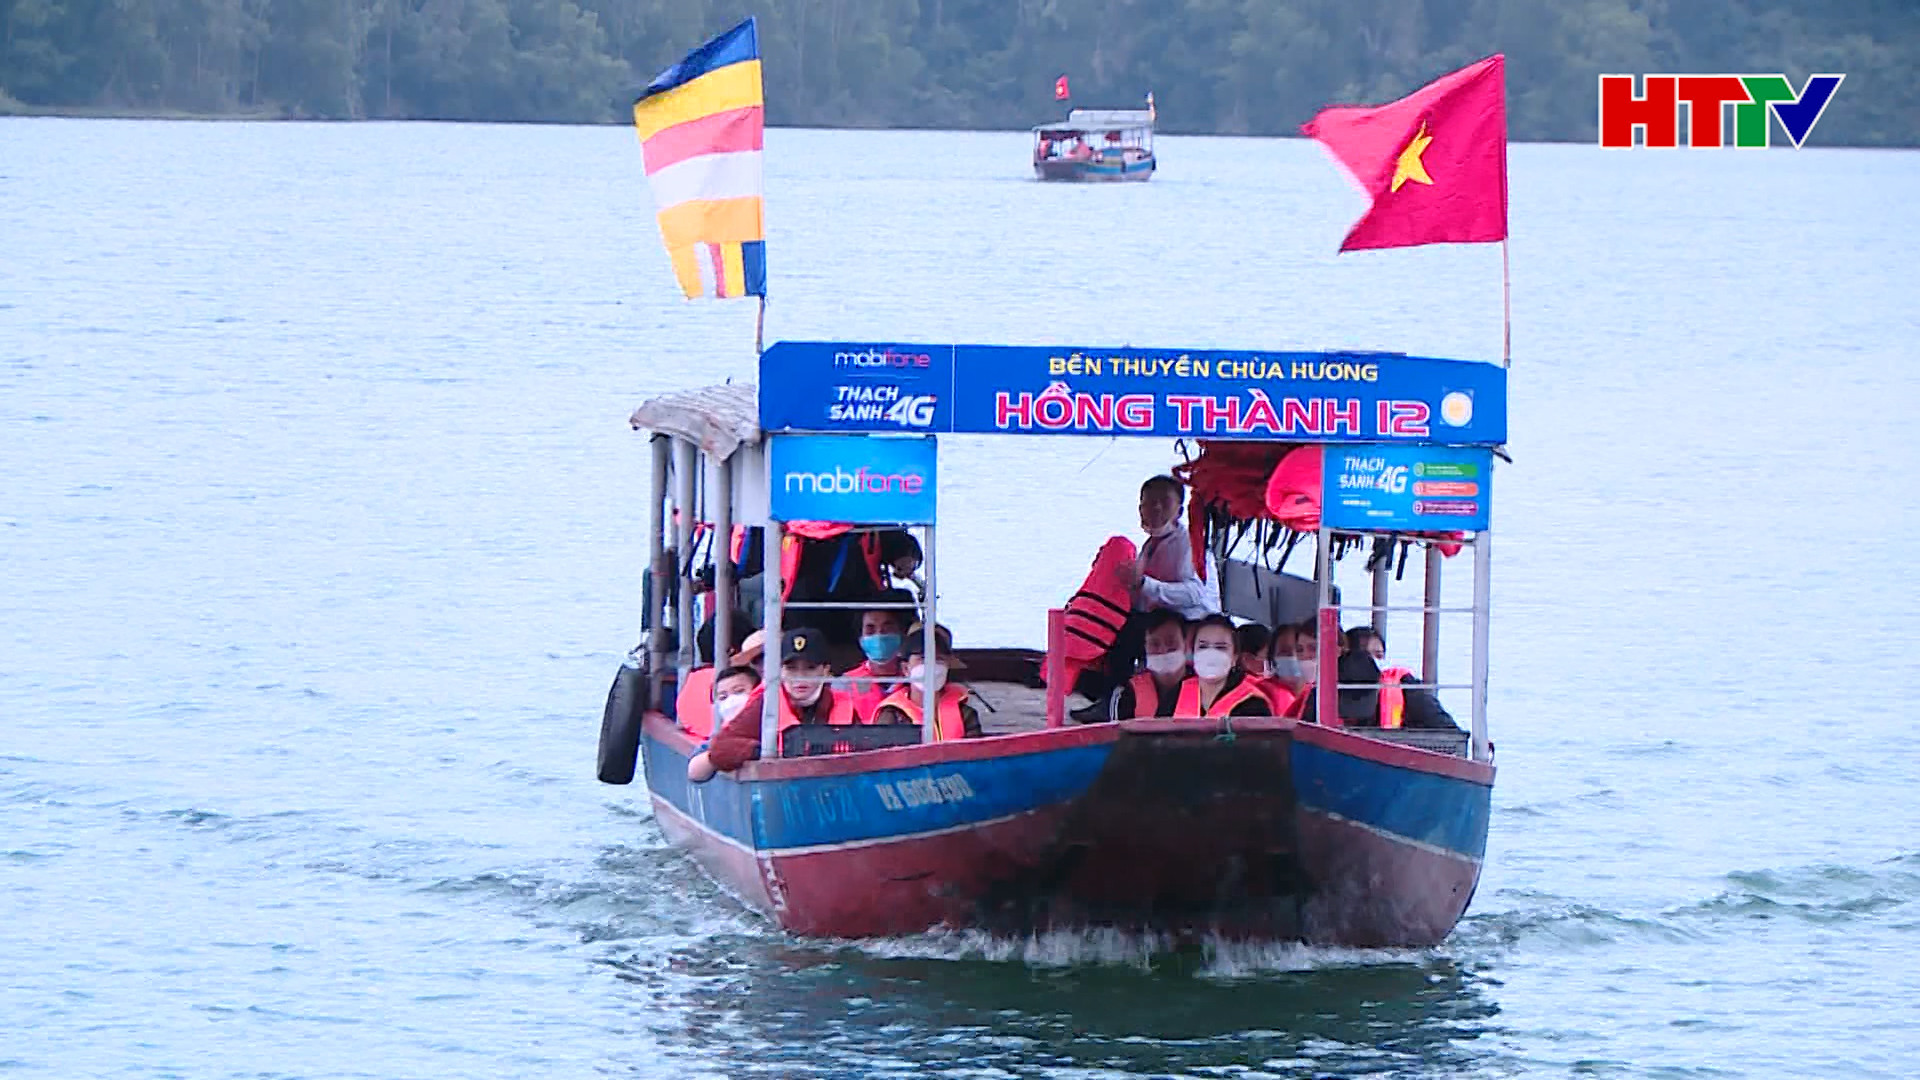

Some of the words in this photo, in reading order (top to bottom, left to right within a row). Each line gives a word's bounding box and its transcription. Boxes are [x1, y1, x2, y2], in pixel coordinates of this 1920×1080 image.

[833, 348, 931, 367] mobifone
[1216, 356, 1284, 380] CHÙA
[1291, 360, 1379, 382] HƯƠNG
[829, 403, 883, 420] SANH
[884, 395, 938, 427] 4G
[995, 380, 1155, 431] HỒNG
[1166, 388, 1361, 435] THÀNH
[1376, 400, 1431, 438] 12
[785, 465, 924, 495] mobifone
[1376, 465, 1409, 494] 4G
